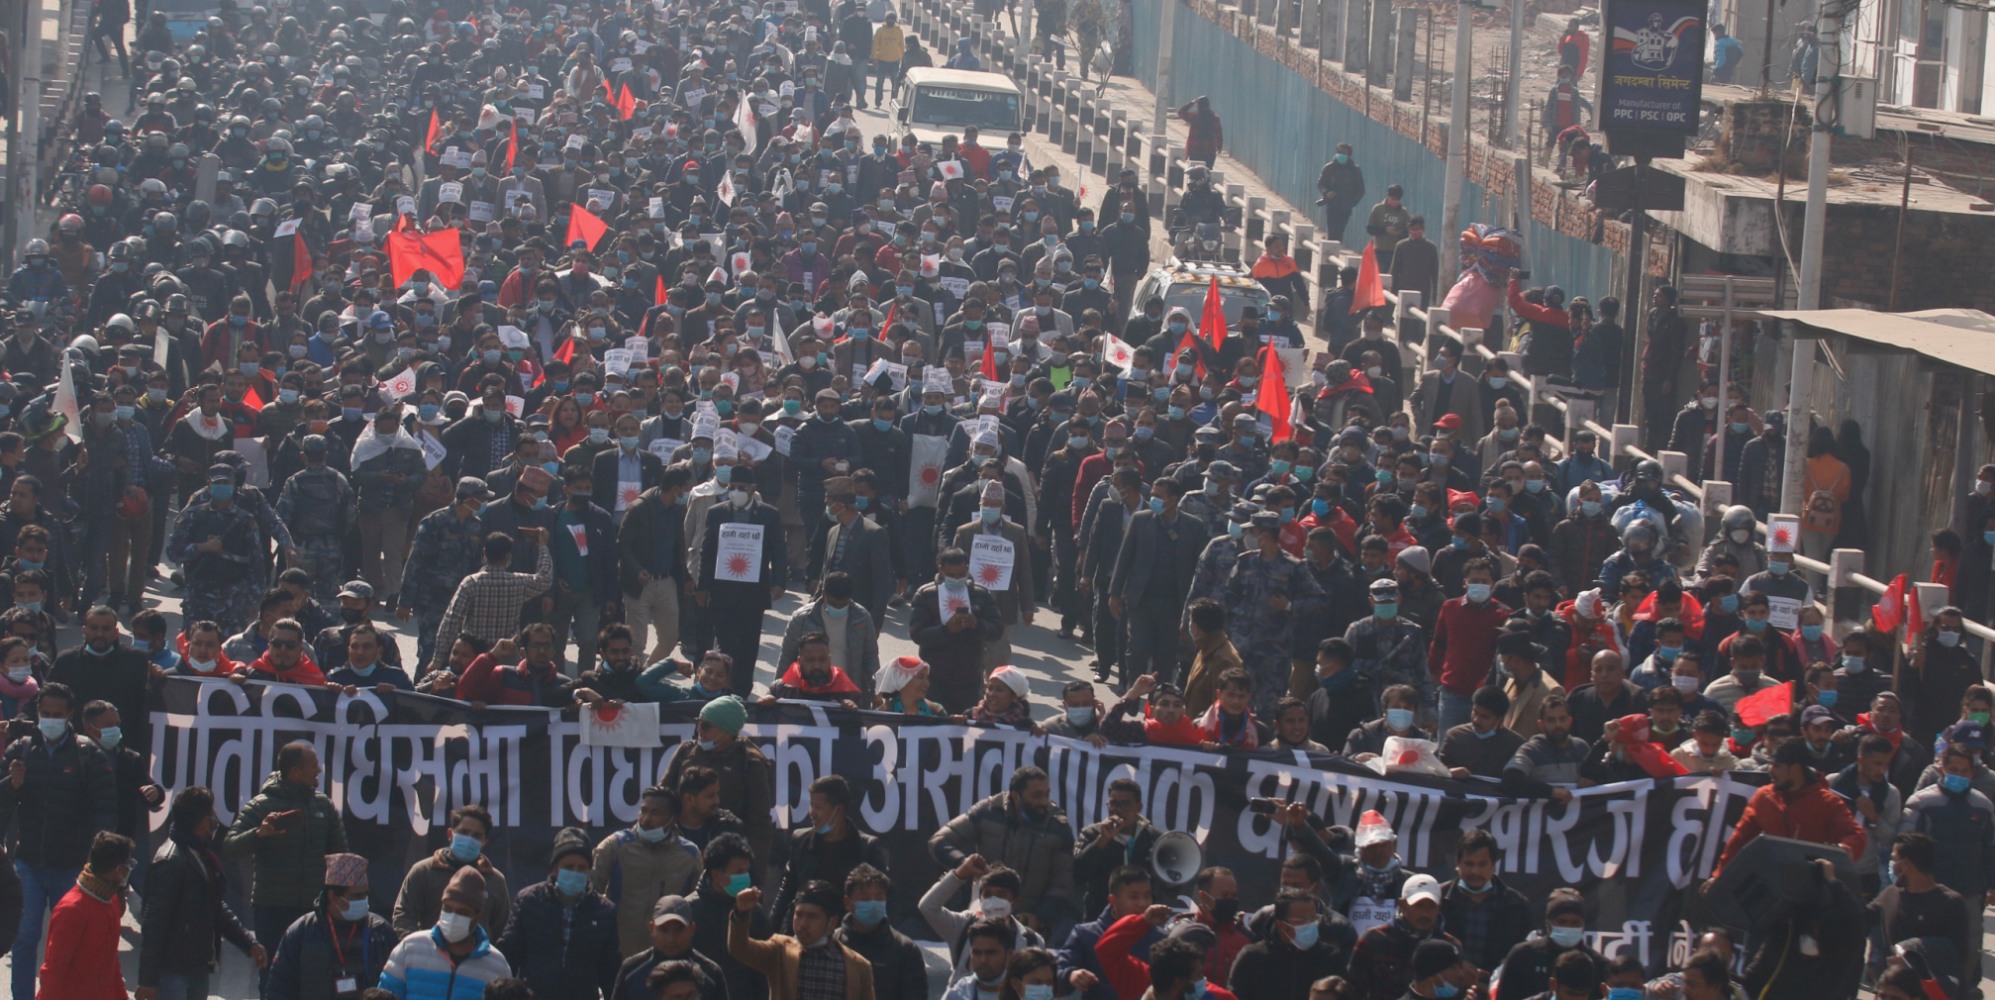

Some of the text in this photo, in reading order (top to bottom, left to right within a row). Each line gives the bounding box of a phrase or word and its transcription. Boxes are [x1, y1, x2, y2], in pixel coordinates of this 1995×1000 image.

[1614, 75, 1655, 88] जगदम्बा
[1618, 99, 1671, 110] Manufacturer
[1613, 109, 1633, 119] PPC
[1640, 110, 1660, 121] PSC
[1666, 112, 1686, 122] OPC
